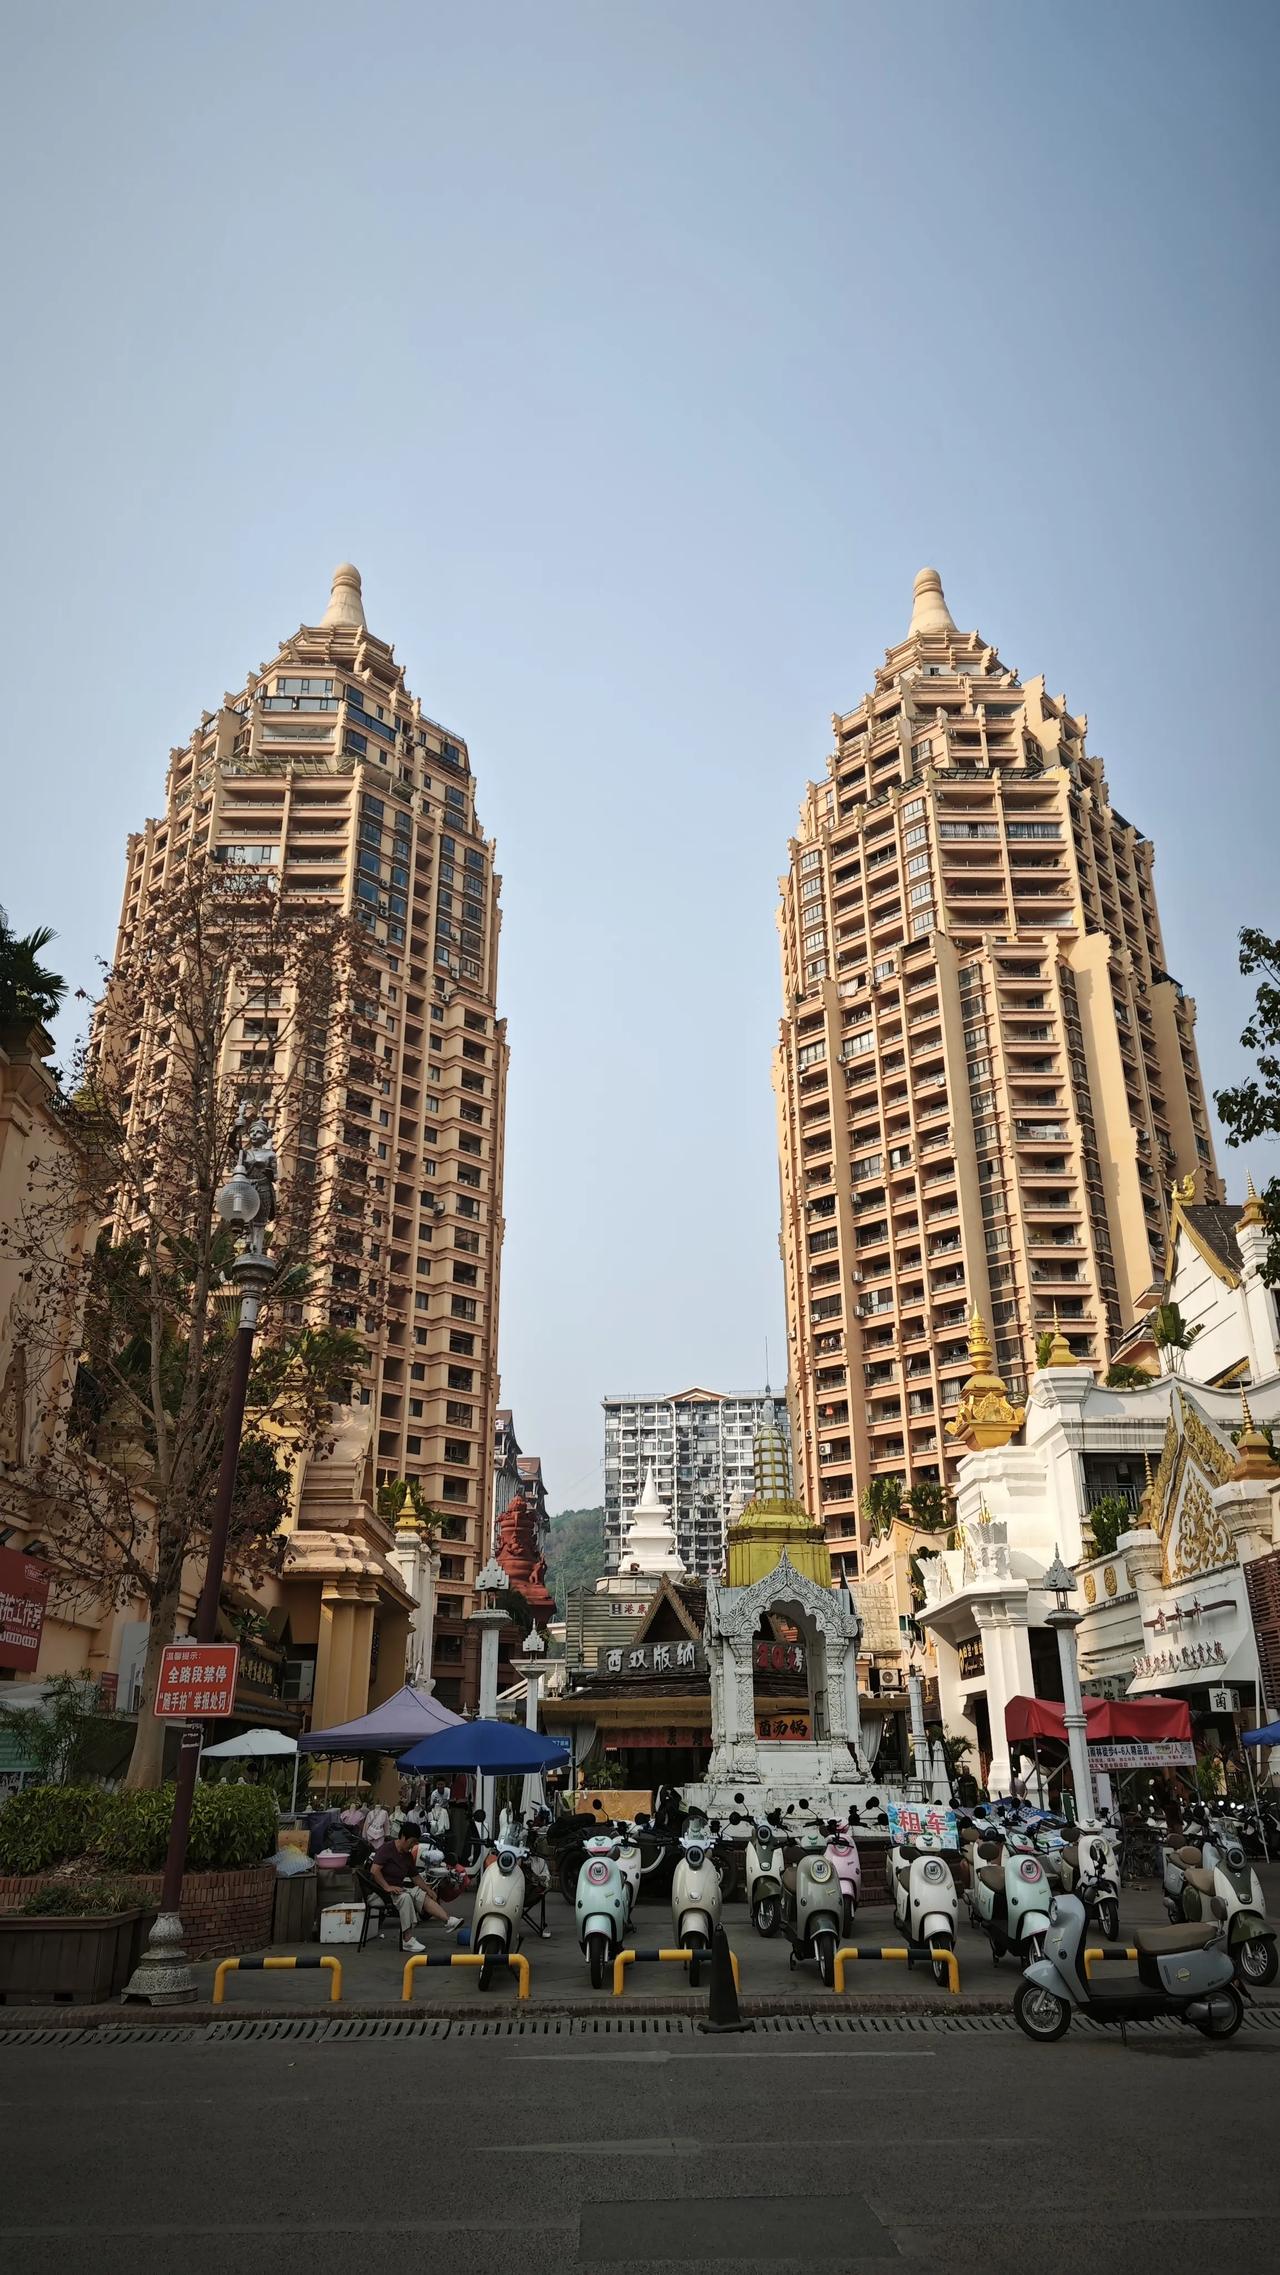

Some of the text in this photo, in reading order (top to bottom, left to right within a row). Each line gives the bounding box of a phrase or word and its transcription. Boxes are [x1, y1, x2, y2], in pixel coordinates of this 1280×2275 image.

[606, 1643, 696, 1672] 西双版纳
[168, 1665, 228, 1684] 全路段禁停
[759, 1720, 808, 1737] 菌汤锅
[898, 1808, 948, 1834] 租车
